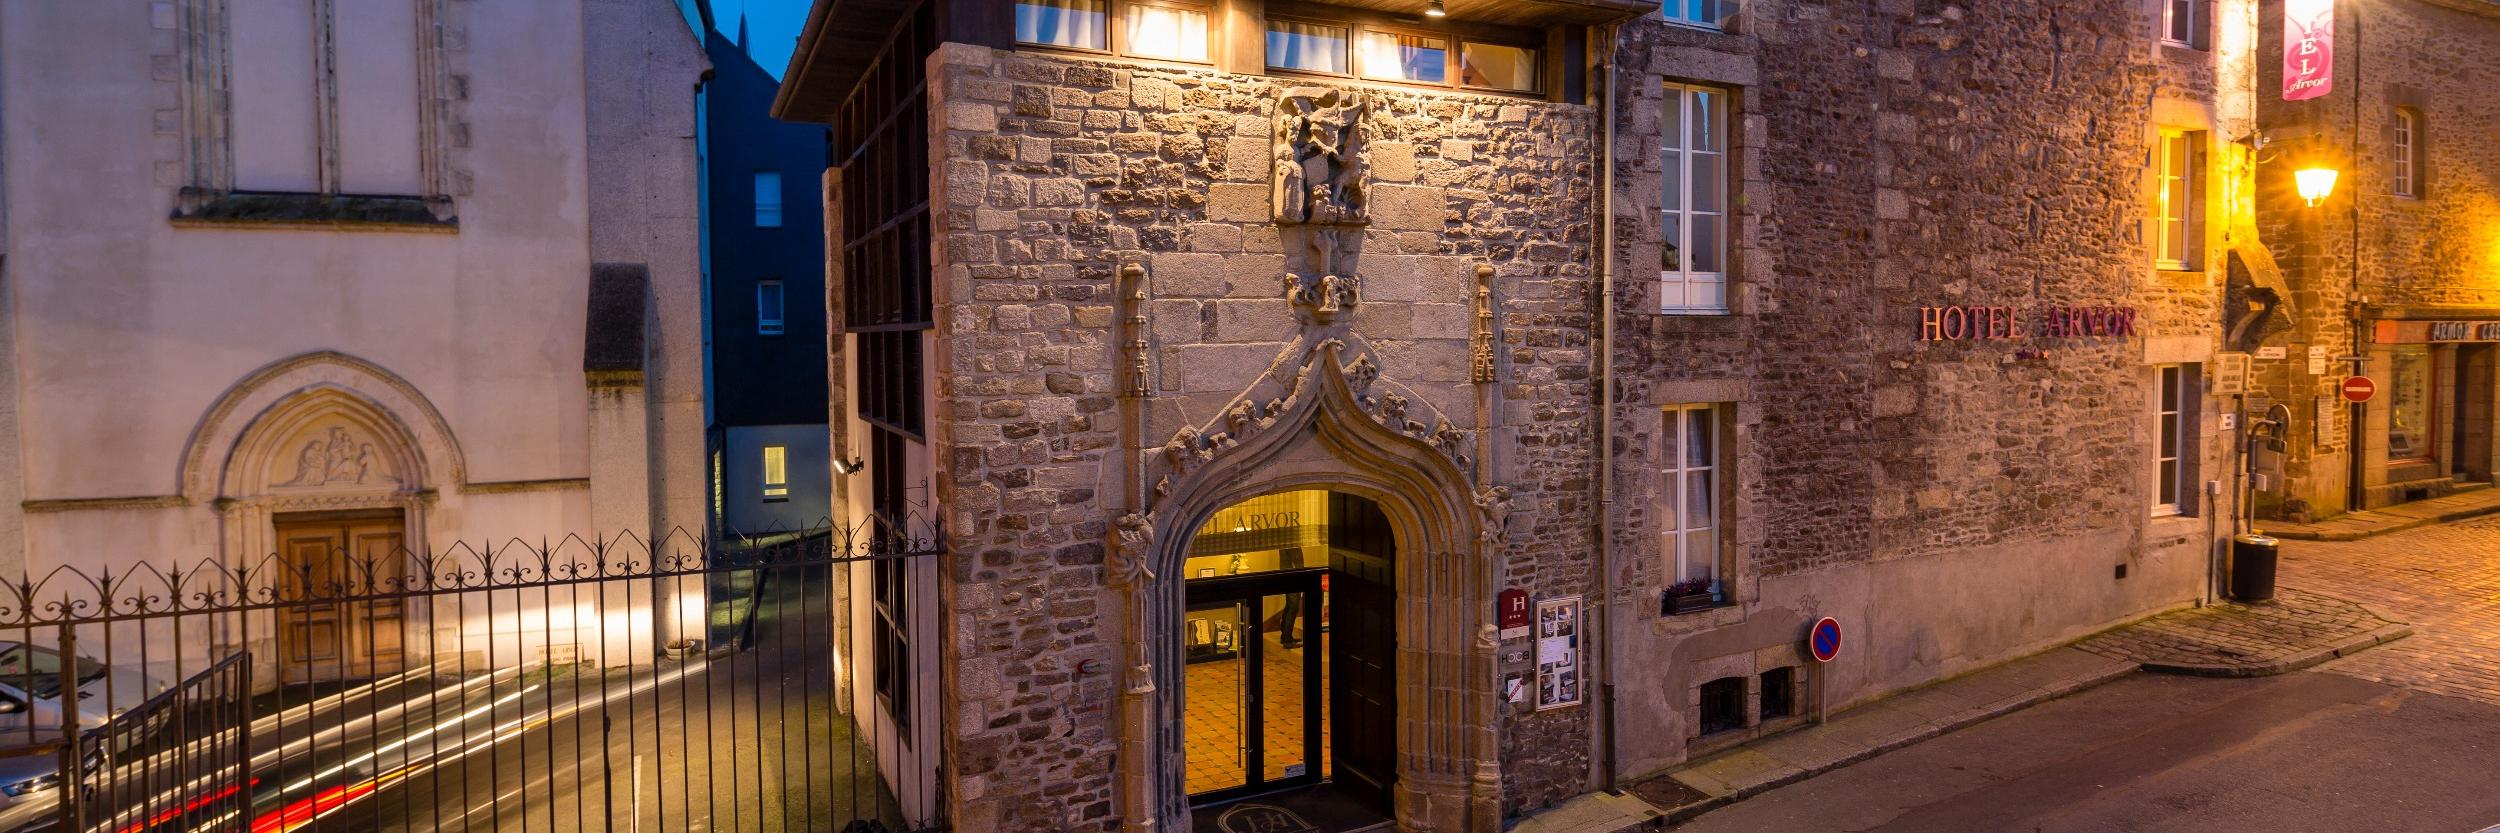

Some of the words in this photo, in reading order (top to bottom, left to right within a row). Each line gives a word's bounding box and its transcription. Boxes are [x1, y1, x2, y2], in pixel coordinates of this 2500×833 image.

[2286, 78, 2328, 93] Arvor
[1920, 305, 2026, 341] HOTEL
[2047, 303, 2137, 337] ARVOR
[1233, 511, 1300, 532] ARVOR
[1513, 596, 1526, 611] H
